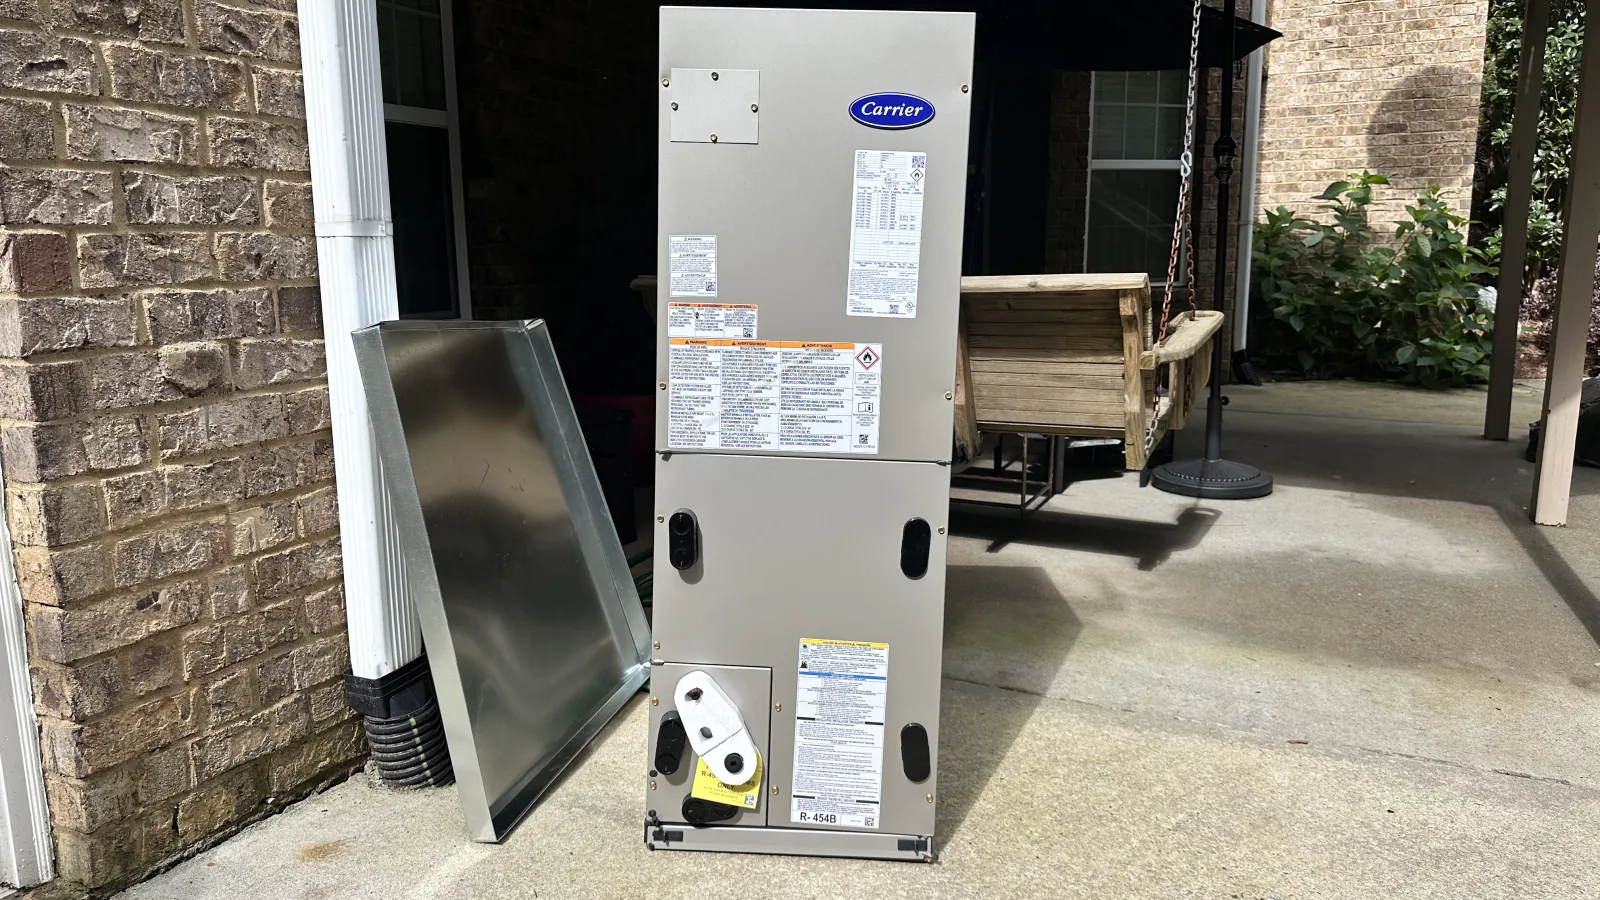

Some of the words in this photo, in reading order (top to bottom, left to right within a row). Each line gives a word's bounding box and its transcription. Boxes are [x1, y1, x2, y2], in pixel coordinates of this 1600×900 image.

[861, 101, 923, 116] Carrier
[701, 770, 716, 778] R-45
[717, 782, 735, 790] ONLY
[812, 813, 837, 823] 454B
